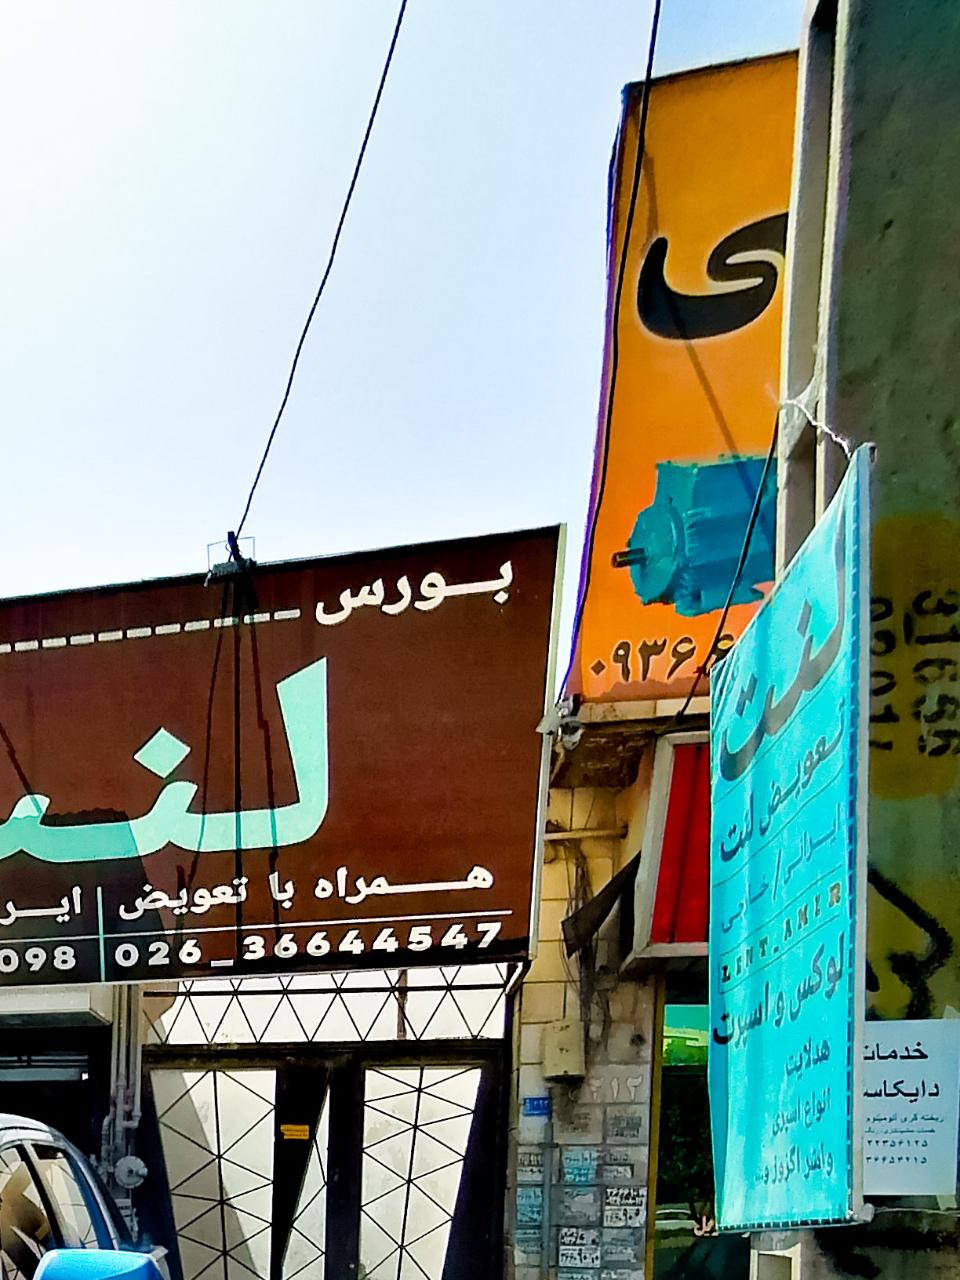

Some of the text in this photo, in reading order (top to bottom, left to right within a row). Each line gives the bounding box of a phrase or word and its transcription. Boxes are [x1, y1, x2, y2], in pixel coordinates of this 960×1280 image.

[316, 557, 514, 626] بورس
[590, 633, 736, 682] ۰۹۳۶۶
[721, 790, 754, 862] لنت
[119, 864, 494, 920] همراه با تعویض
[114, 922, 502, 968] 026_36644547
[804, 1086, 830, 1128] انواع
[863, 1080, 939, 1103] دایکاس
[772, 1144, 801, 1184] اگزوز
[804, 1142, 834, 1180] واشر
